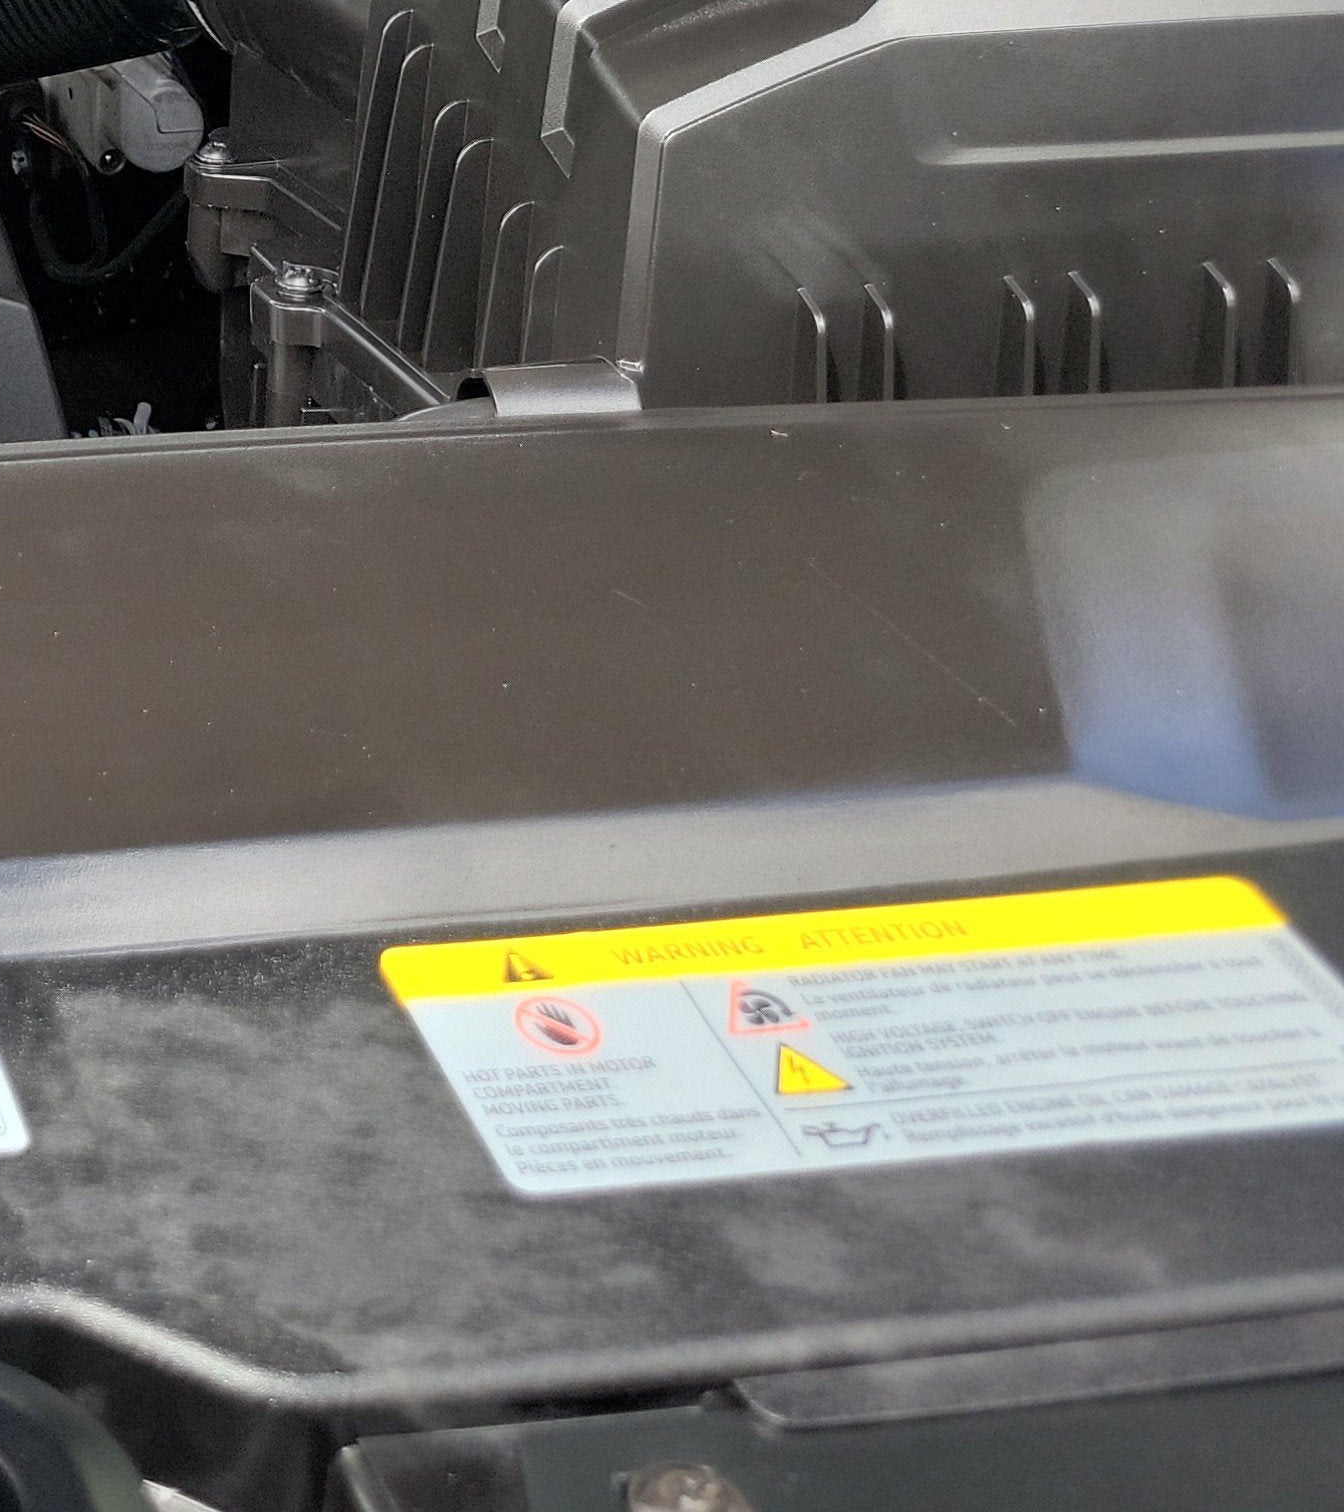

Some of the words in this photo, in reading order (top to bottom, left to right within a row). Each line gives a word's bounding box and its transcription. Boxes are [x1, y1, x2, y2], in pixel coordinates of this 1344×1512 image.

[610, 935, 764, 966] WARNING
[799, 920, 968, 949] ATTENTION
[505, 1063, 562, 1081] PARTS
[567, 1062, 586, 1076] IN
[589, 1055, 657, 1074] MOTOR
[482, 1098, 558, 1116] MOVING
